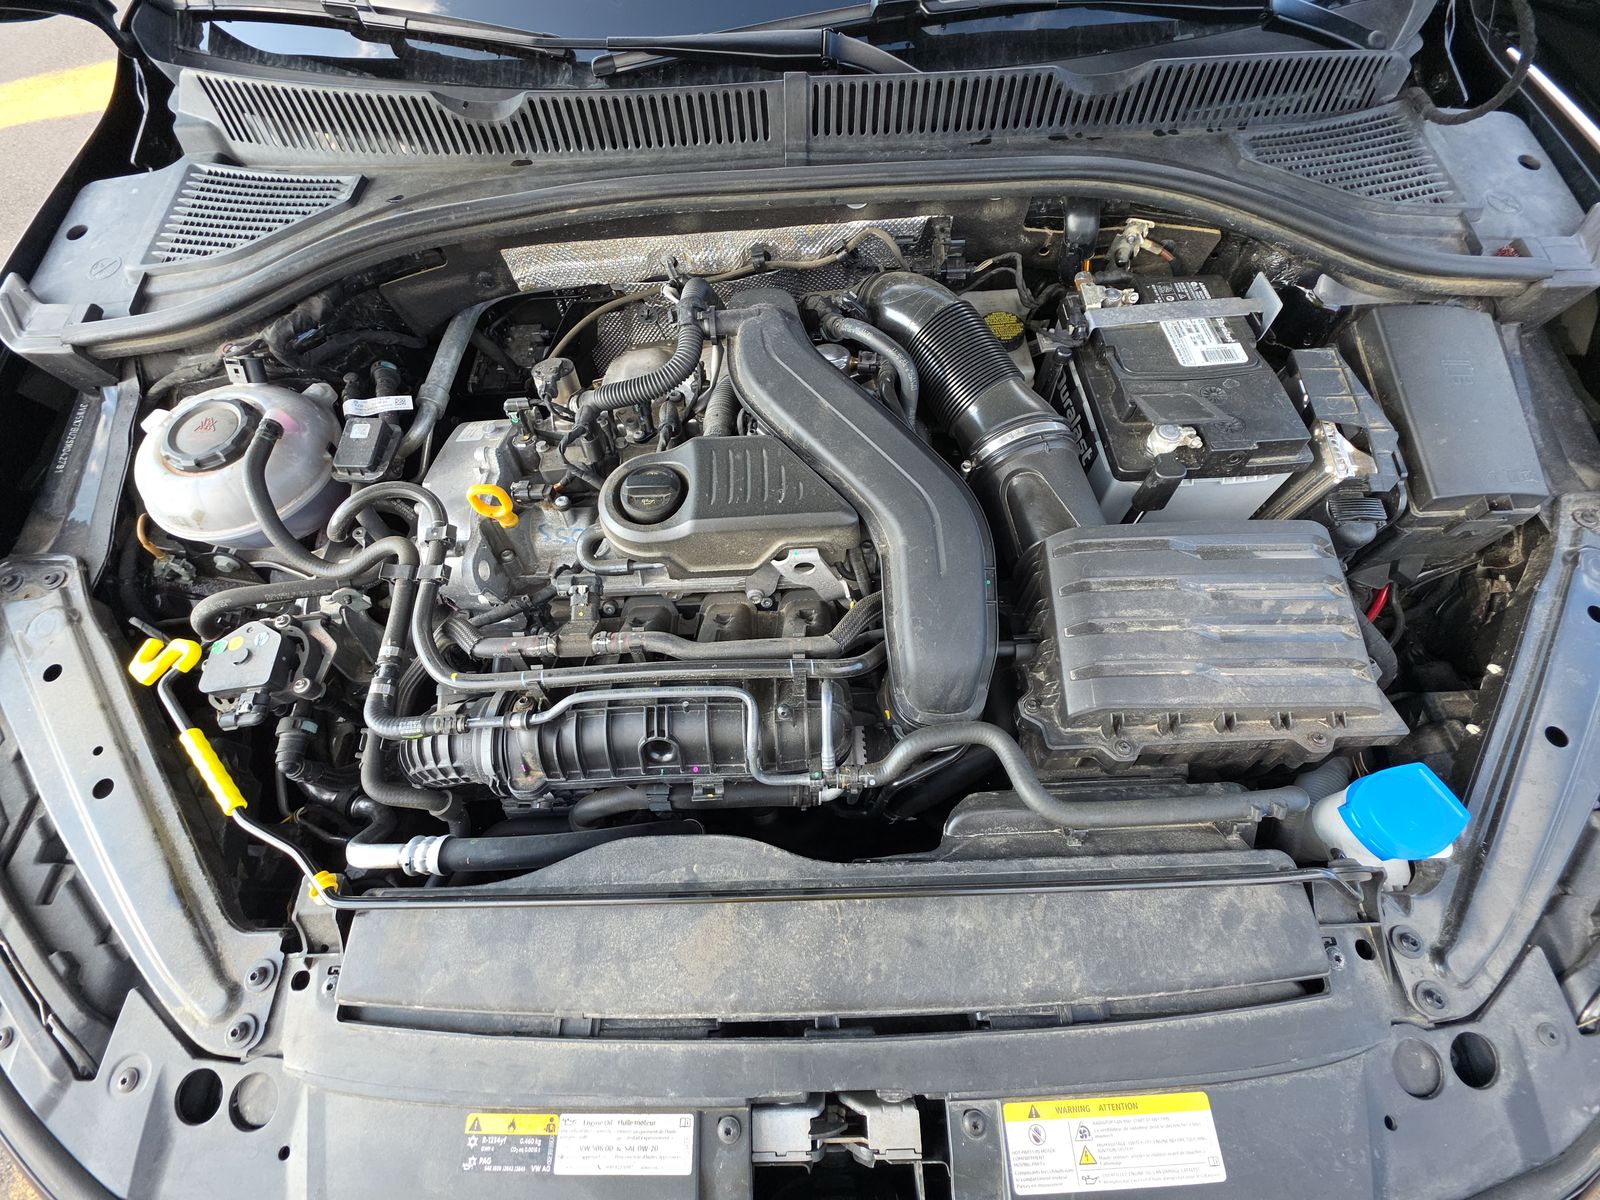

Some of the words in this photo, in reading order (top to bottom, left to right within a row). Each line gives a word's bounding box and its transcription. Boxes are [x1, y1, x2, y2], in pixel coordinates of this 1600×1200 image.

[1055, 1104, 1091, 1115] WARNING
[1098, 1102, 1139, 1112] ATTENTION
[535, 1137, 542, 1147] kg
[478, 1157, 492, 1165] PAG
